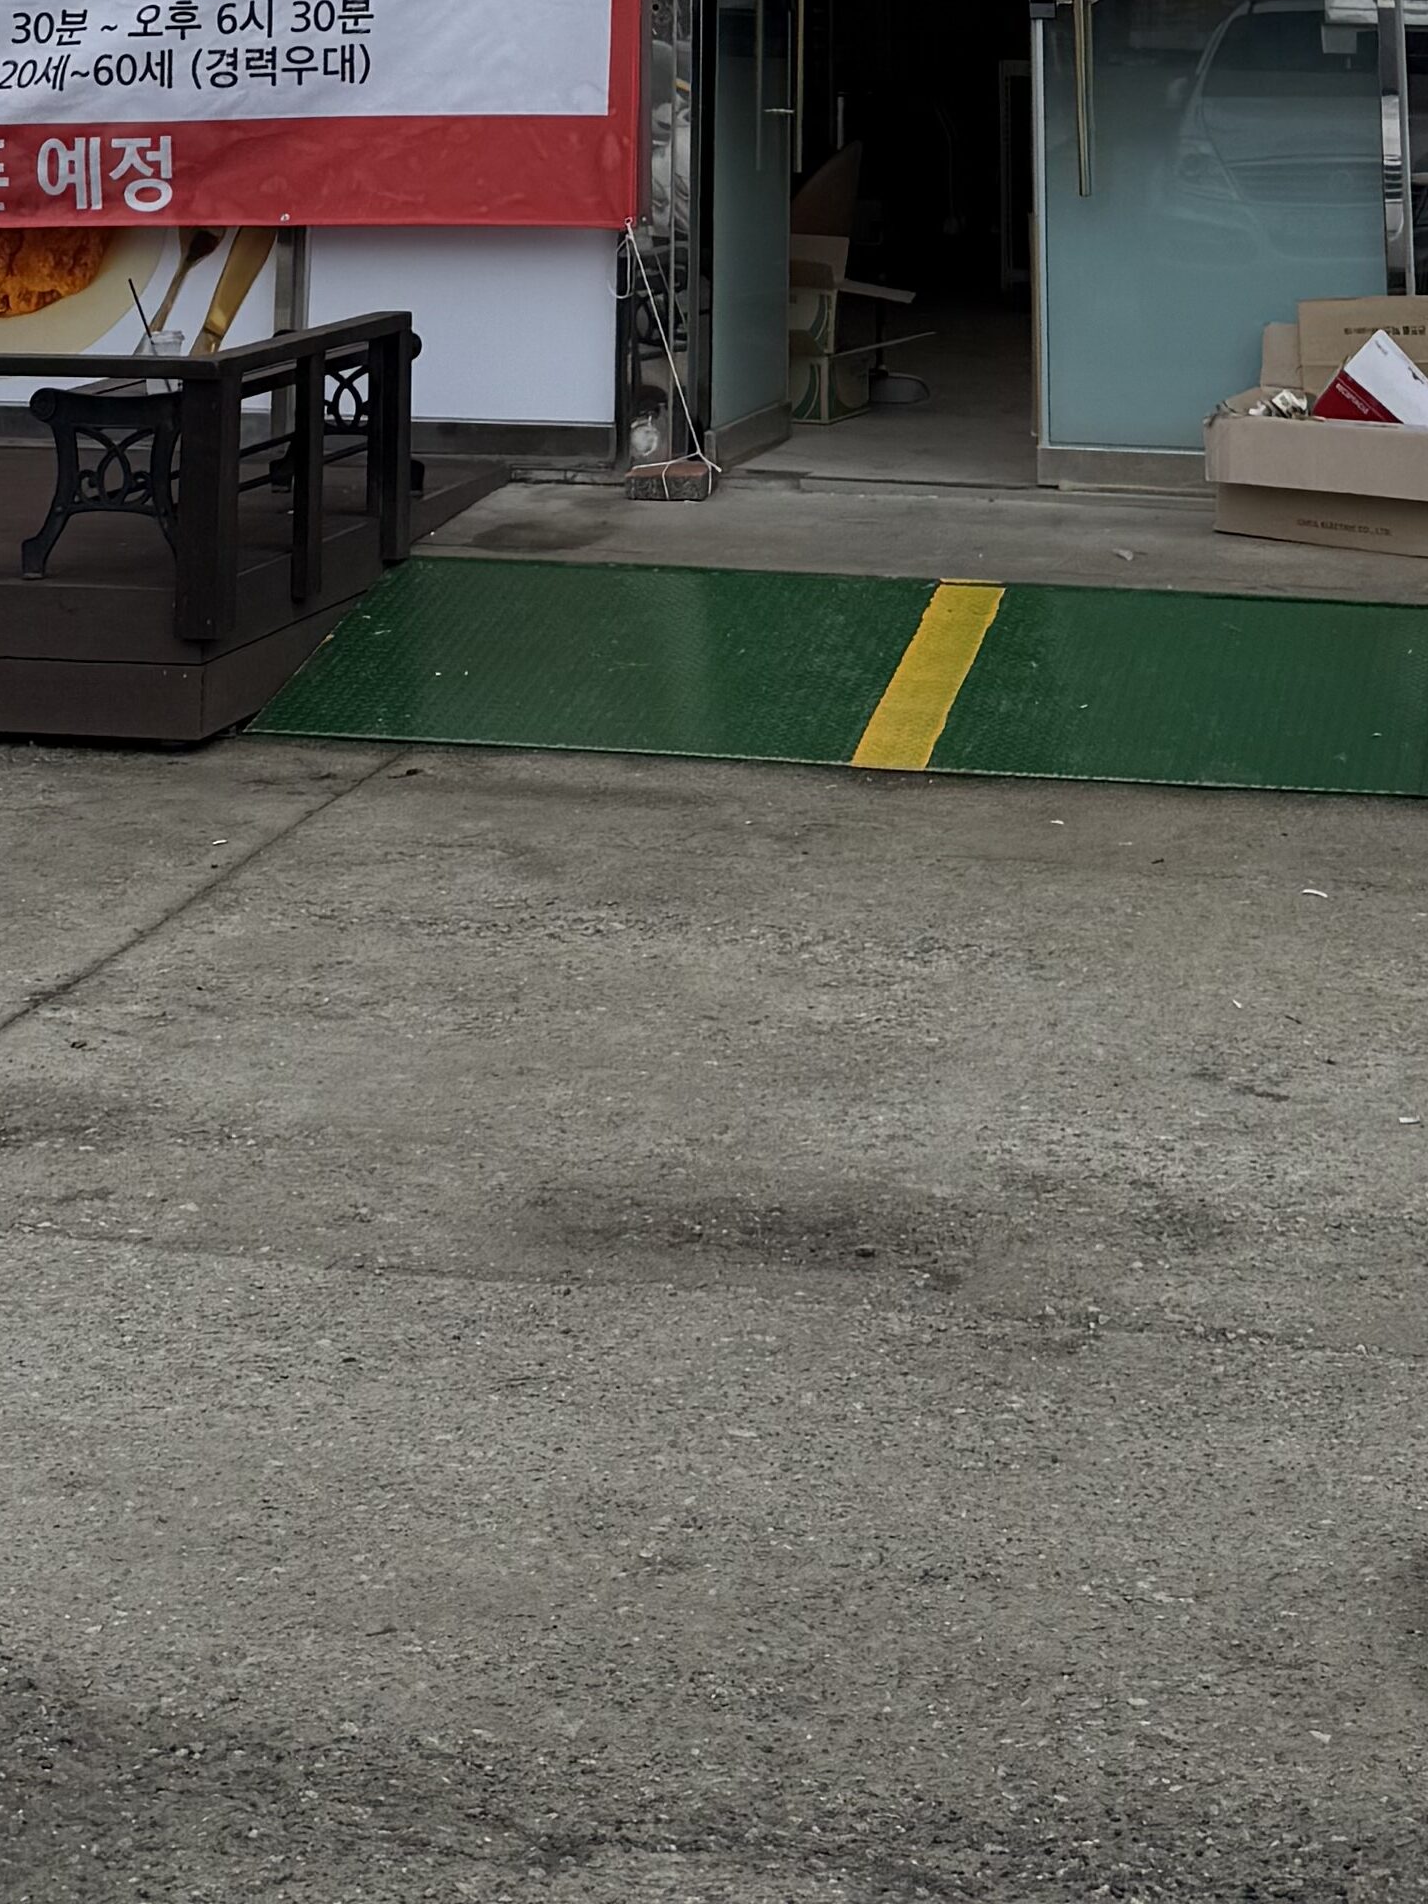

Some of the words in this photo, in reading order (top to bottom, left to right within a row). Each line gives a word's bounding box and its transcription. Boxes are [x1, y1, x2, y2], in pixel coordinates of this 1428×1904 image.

[12, 10, 87, 46] 30분
[128, 2, 202, 40] 오후
[192, 44, 370, 89] (경력우대)
[37, 136, 172, 212] 예정
